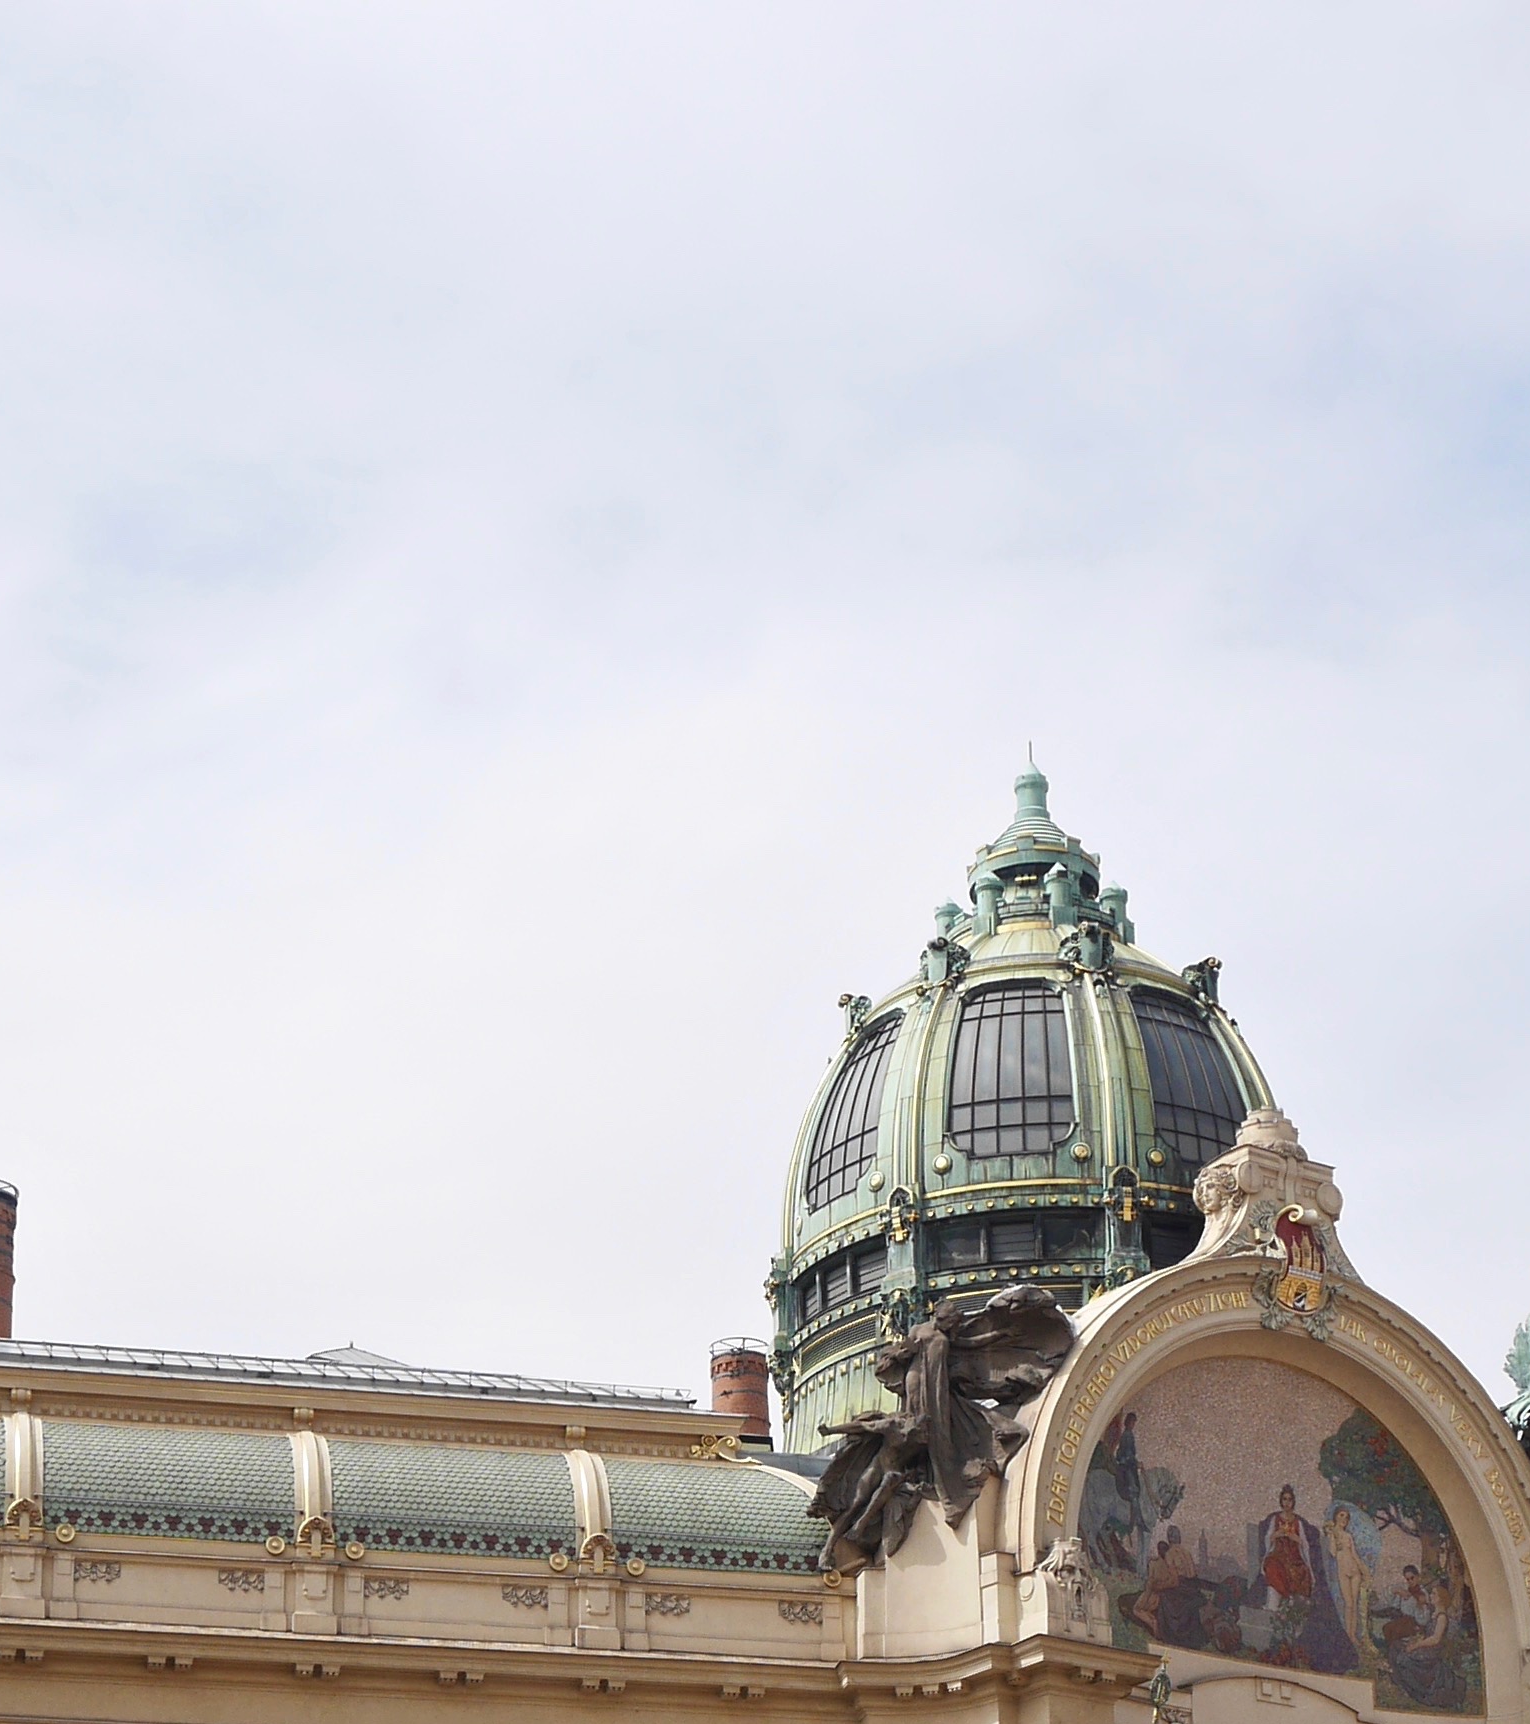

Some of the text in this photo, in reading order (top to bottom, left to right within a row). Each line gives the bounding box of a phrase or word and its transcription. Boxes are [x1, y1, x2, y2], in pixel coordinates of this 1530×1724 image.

[1337, 1314, 1368, 1345] JAK
[1047, 1471, 1069, 1527] ZDAR
[1111, 1312, 1173, 1366] VZDORUJ
